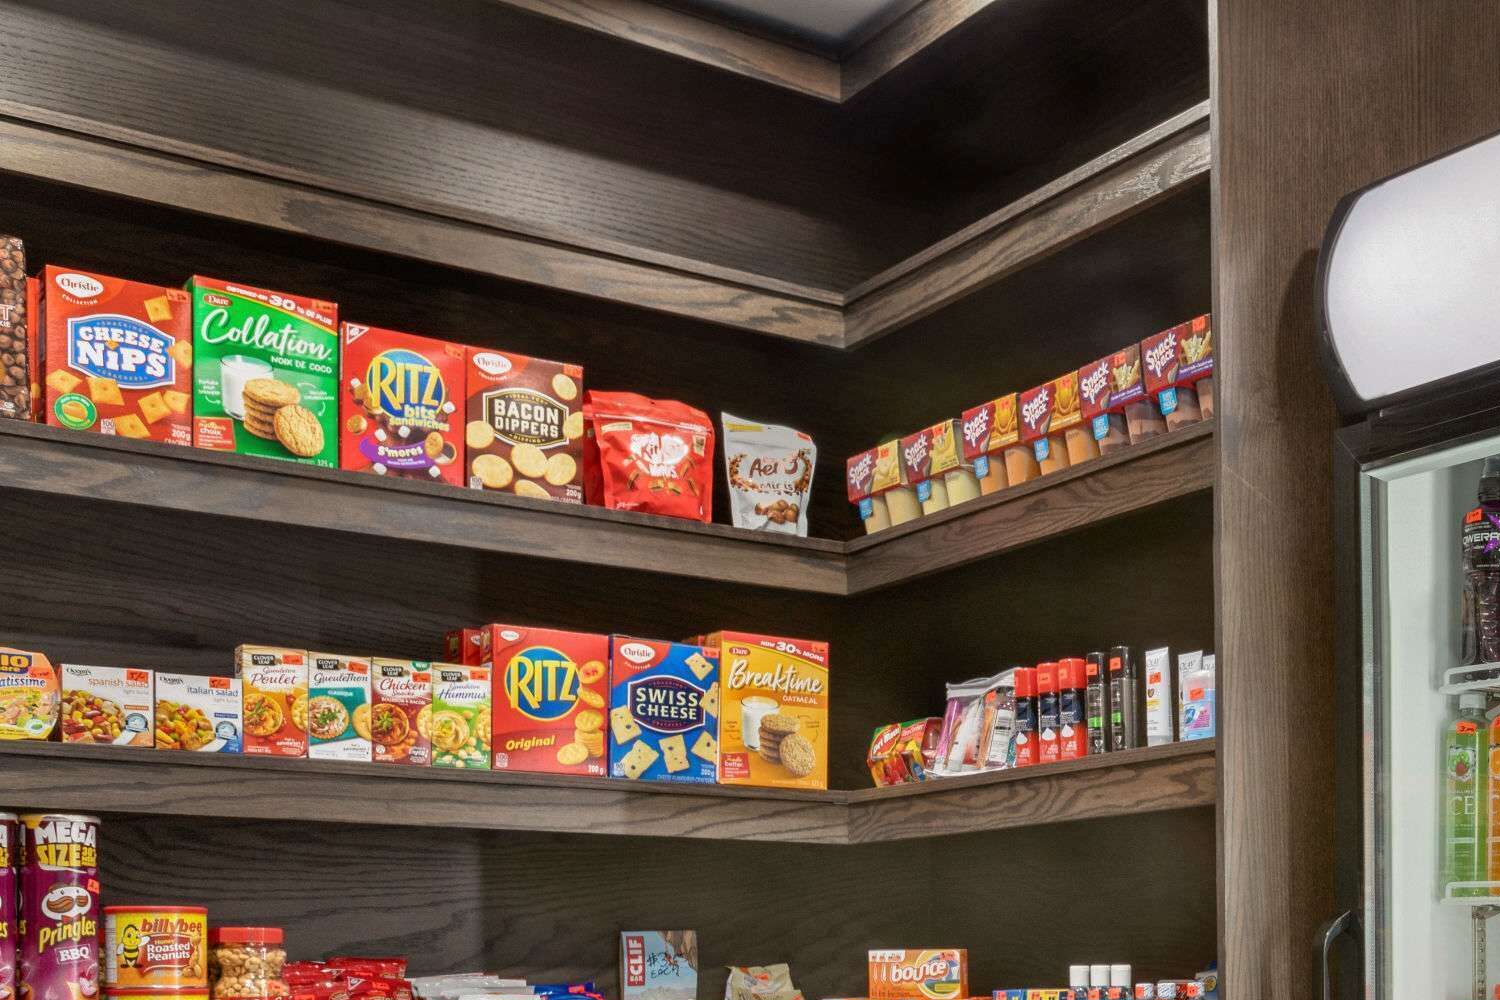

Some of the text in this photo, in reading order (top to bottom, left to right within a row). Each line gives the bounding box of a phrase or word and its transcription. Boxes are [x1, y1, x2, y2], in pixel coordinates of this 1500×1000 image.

[269, 294, 295, 311] 30
[78, 326, 165, 354] CHEESE
[201, 307, 331, 361] Collation
[1144, 332, 1177, 367] Snack
[271, 356, 332, 374] NOIX DE COCO
[371, 357, 440, 411] RITZ
[1080, 362, 1110, 395] Snack
[404, 403, 436, 420] bits
[494, 399, 559, 425] BACON
[1022, 387, 1049, 417] Snack
[963, 407, 989, 436] Snack
[377, 446, 423, 457] S'mores
[905, 434, 928, 461] Snack
[850, 453, 873, 477] Snack
[623, 646, 652, 659] Christie
[760, 640, 824, 662] NOW 30 MORE
[88, 678, 124, 690] spanish
[251, 673, 298, 686] Poulet
[379, 678, 426, 691] Chicken
[508, 655, 579, 709] RITZ
[728, 658, 823, 694] Breaktime
[186, 686, 240, 697] italian salad
[437, 688, 486, 700] Hummus
[636, 687, 698, 708] SWISS
[783, 694, 818, 705] OATMEAL
[636, 703, 698, 720] CHEESE
[505, 734, 556, 752] Original
[35, 821, 97, 845] MEGA
[37, 847, 82, 868] SIZE
[39, 920, 97, 954] Pringles
[58, 946, 90, 961] BBQ
[147, 943, 191, 953] Roasted
[147, 951, 191, 962] Peanuts
[629, 939, 643, 975] CLIF
[890, 960, 948, 984] bounce
